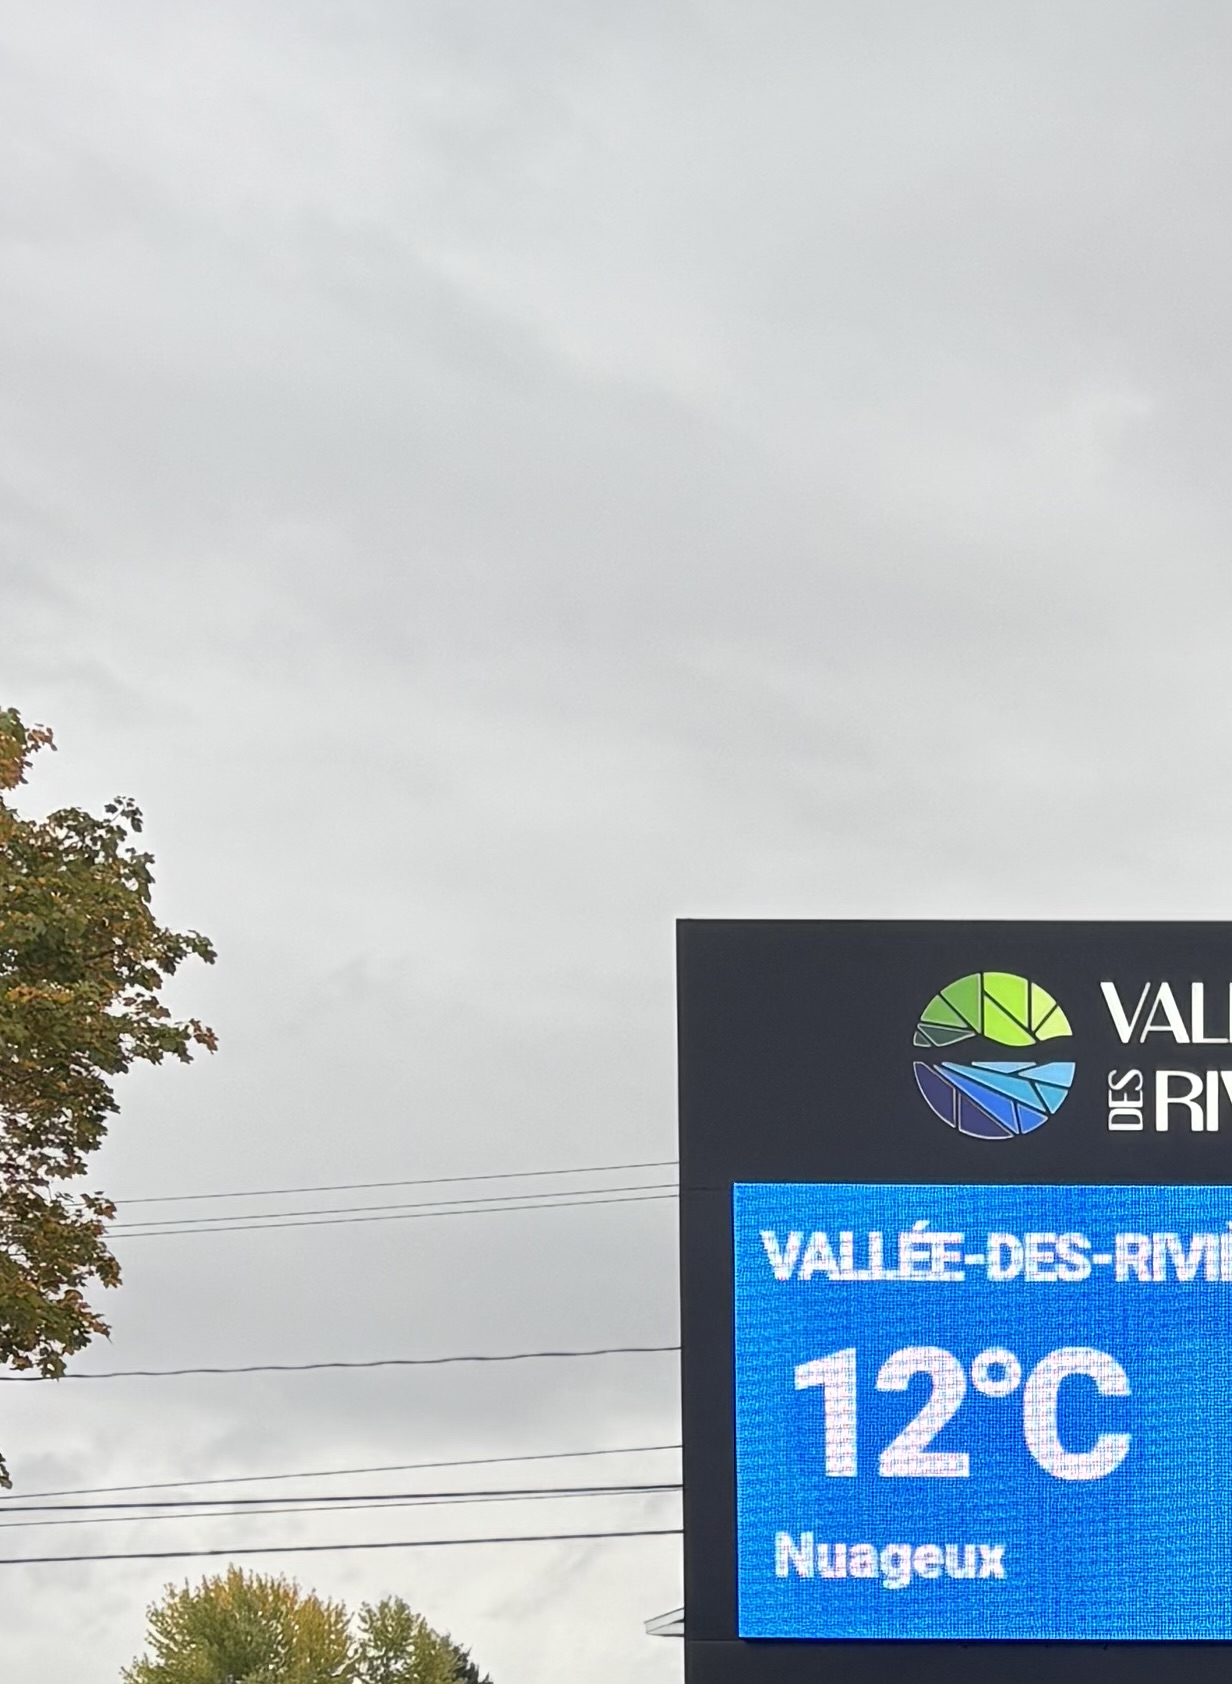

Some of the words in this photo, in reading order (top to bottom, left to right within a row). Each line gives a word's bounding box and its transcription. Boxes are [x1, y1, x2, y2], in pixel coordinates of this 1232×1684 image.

[1108, 1068, 1144, 1131] DES
[795, 1347, 1131, 1481] 12°C
[775, 1532, 1007, 1590] Nuageux
